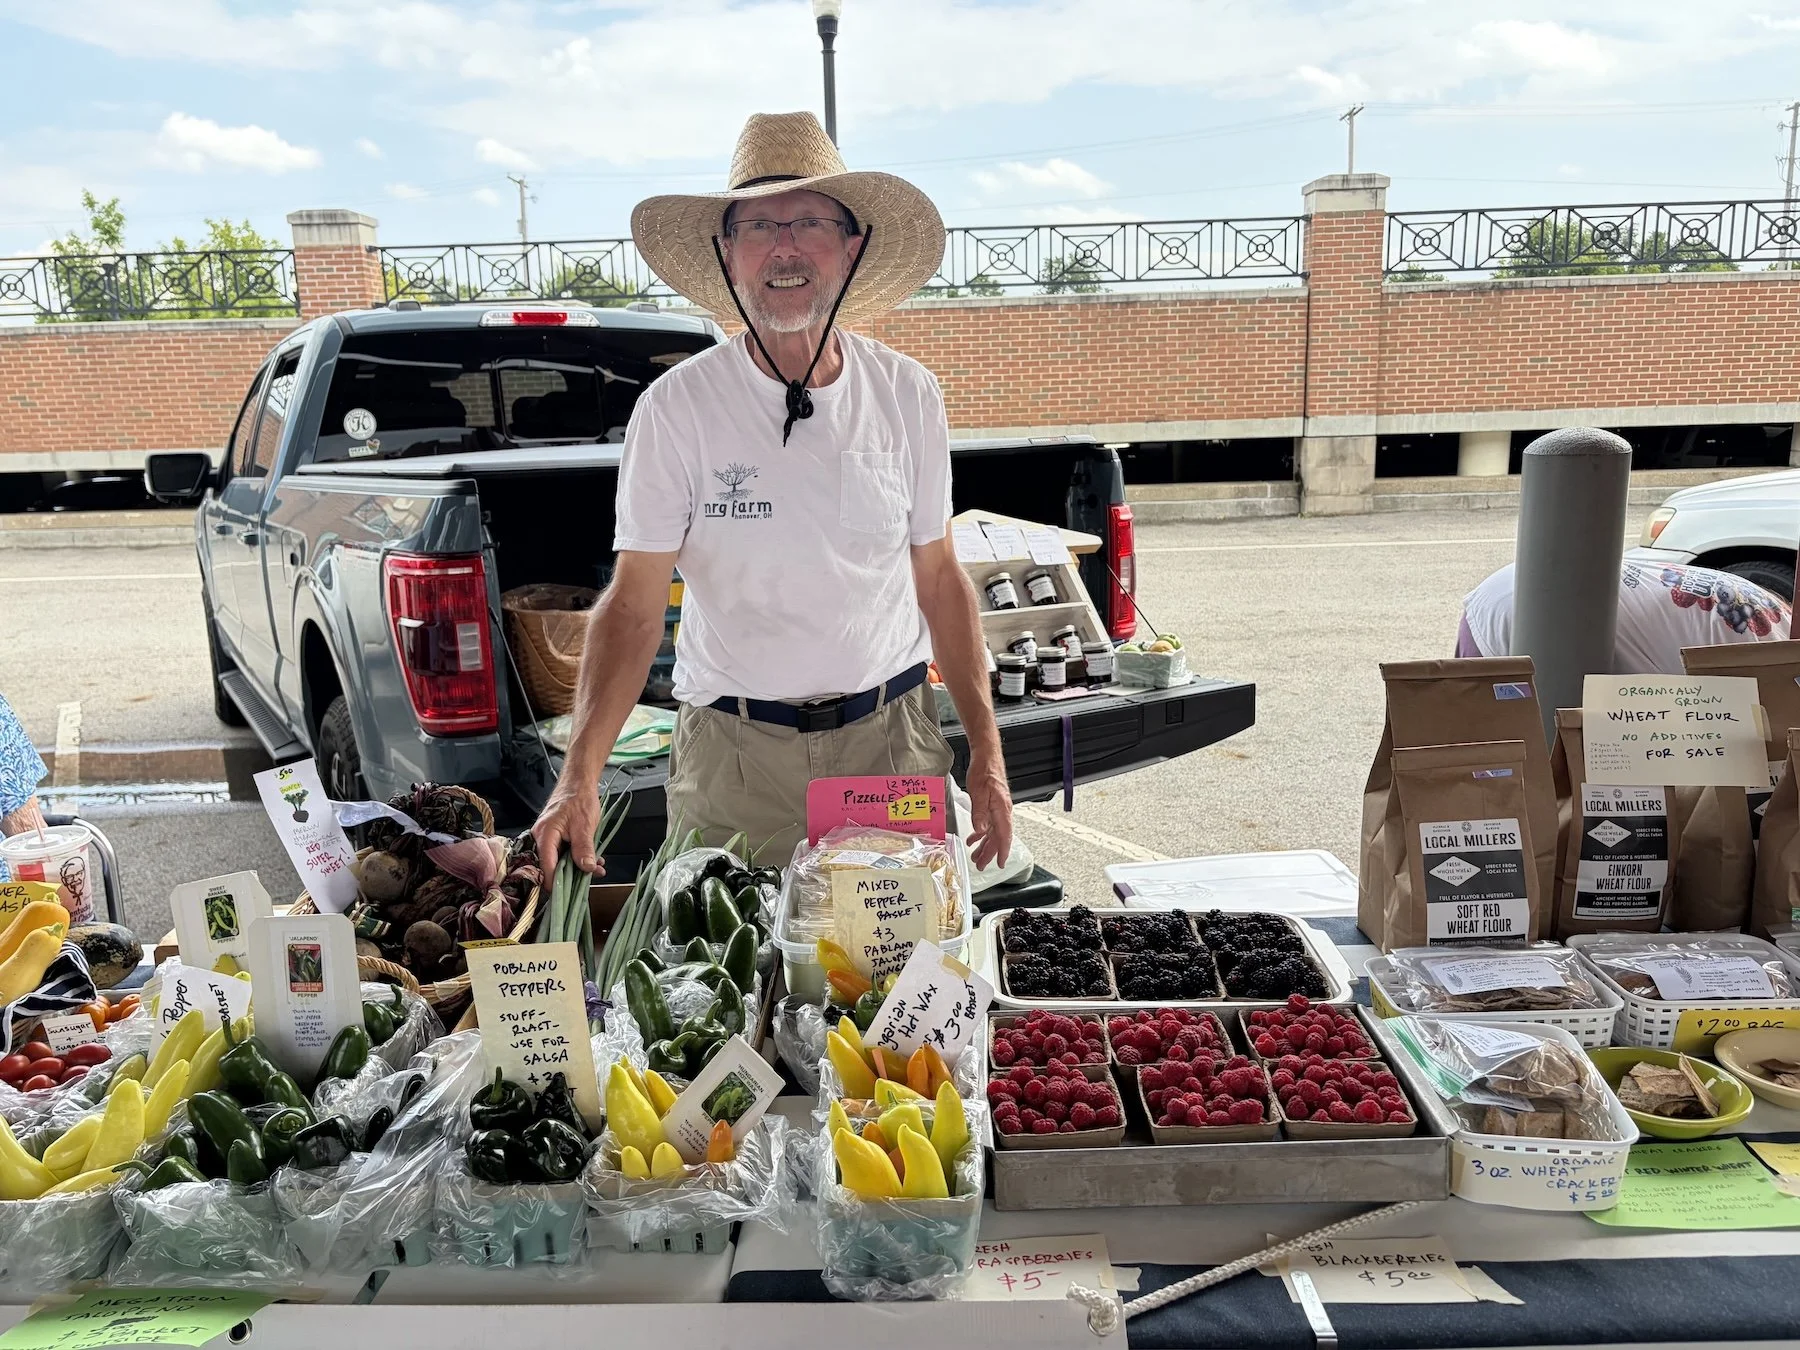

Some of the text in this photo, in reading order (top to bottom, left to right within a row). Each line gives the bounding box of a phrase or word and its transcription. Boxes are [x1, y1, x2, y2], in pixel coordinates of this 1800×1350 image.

[704, 500, 772, 518] nrg farm
[1618, 686, 1702, 696] ORGANICALLY
[1675, 696, 1723, 706] GROWN
[1607, 709, 1740, 723] WHEAT FLOUR
[1650, 732, 1722, 741] ADDITIVES
[1646, 747, 1725, 760] FOR SALE
[1585, 800, 1662, 812] LOCAL MILLERS
[1425, 832, 1516, 849] LOCAL MILLERS
[306, 842, 321, 854] RED
[306, 852, 334, 870] SUPER
[1608, 864, 1643, 876] EINKORN
[857, 880, 899, 893] MIXED
[1596, 877, 1651, 890] WHEAT FLOUR
[864, 892, 908, 909] PEPPER
[877, 904, 923, 921] BASKET
[1457, 903, 1500, 919] SOFT RED
[1447, 918, 1512, 935] WHEAT FLOUR
[493, 960, 557, 974] POBLANO
[498, 978, 566, 997] PEPPERS
[163, 979, 193, 1024] Pepper
[898, 1013, 920, 1038] Hot
[510, 1036, 569, 1049] USE FOR
[523, 1049, 569, 1065] SALSA
[1472, 1159, 1485, 1175] 3
[1521, 1167, 1584, 1176] WHEAT
[1666, 1164, 1712, 1175] WINTER
[1712, 1161, 1752, 1172] WHEAT
[978, 1251, 1093, 1268] RASPBERRIES
[1312, 1254, 1445, 1267] BLACKBERRIES
[91, 1295, 236, 1308] MEGATRON
